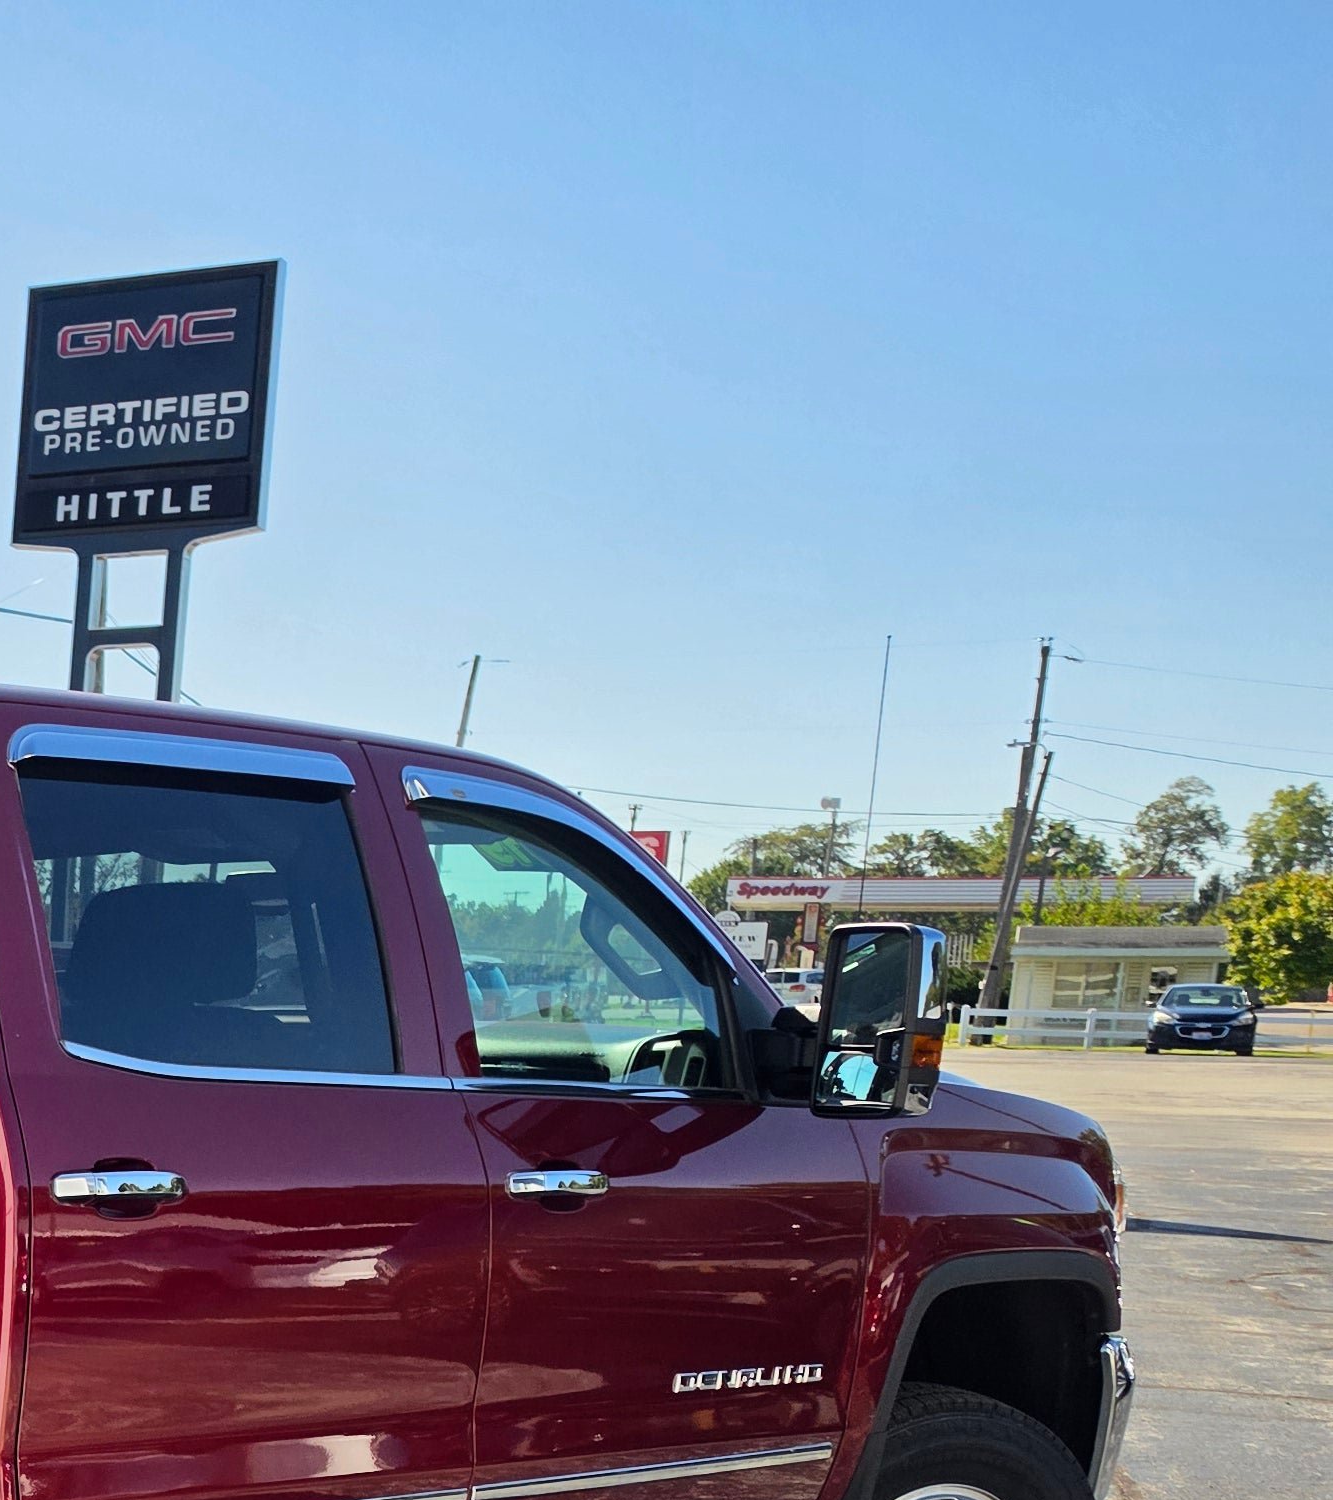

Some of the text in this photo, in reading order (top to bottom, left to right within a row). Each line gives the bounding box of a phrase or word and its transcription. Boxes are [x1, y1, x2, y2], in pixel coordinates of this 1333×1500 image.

[57, 308, 237, 358] GMC
[34, 390, 249, 431] CERTIFIED
[44, 418, 235, 455] PRE-OWNED
[56, 484, 213, 522] HITTLE
[737, 882, 831, 899] Speedway
